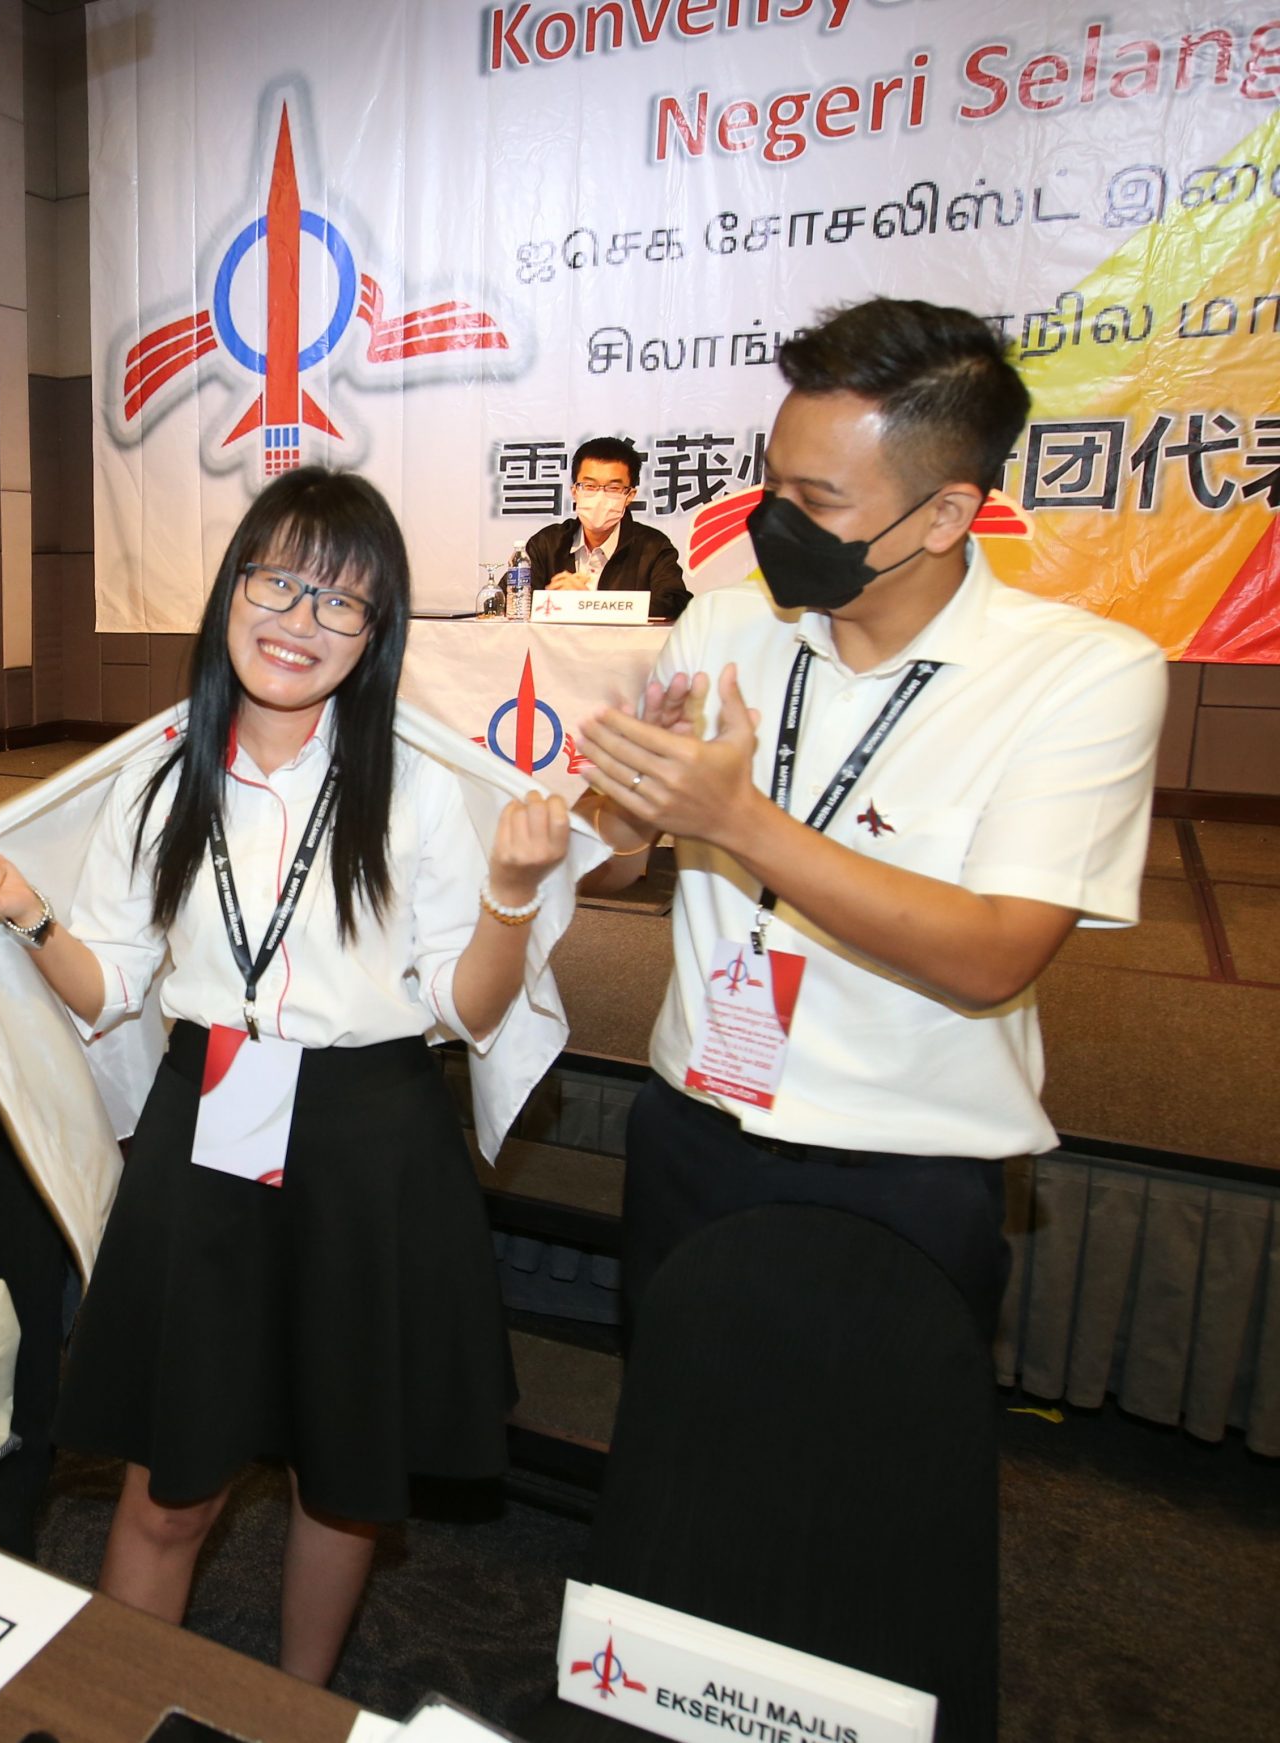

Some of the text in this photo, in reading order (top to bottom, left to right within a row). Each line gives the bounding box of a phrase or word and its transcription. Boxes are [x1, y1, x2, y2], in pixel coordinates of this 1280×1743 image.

[656, 53, 929, 163] Negeri
[578, 600, 634, 611] SPEAKER
[656, 1686, 793, 1743] EKSEKUTIF
[702, 1681, 859, 1743] AHLI MAJLIS
